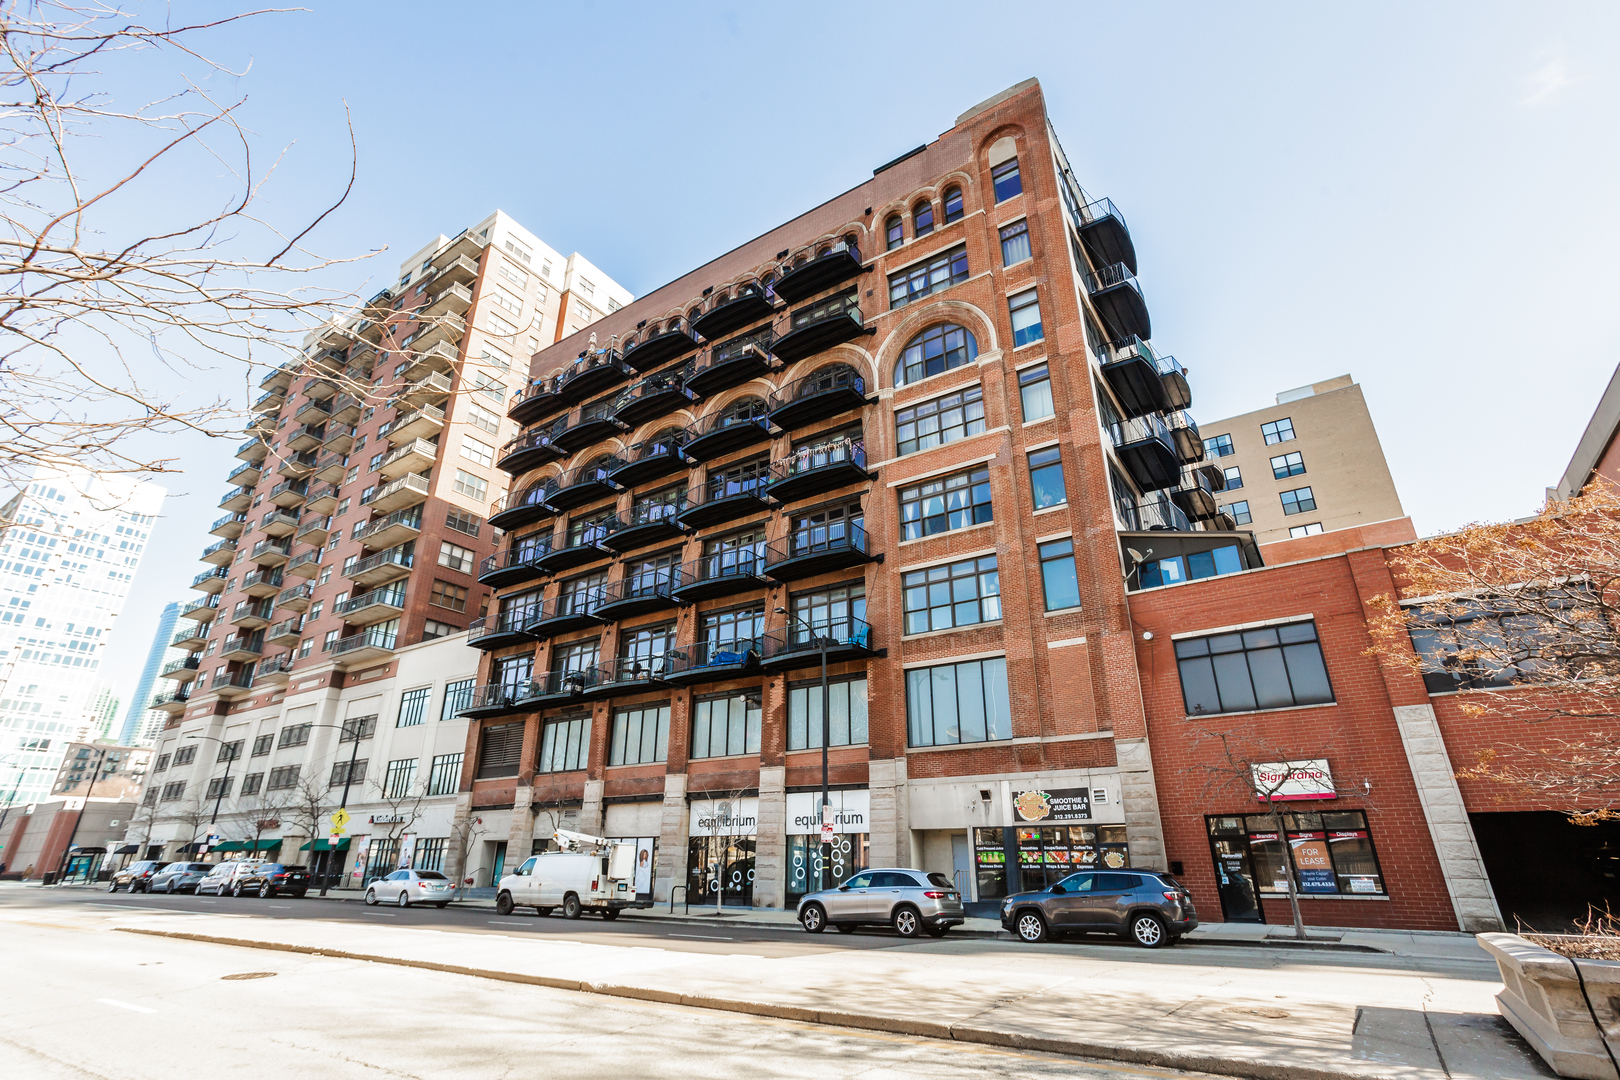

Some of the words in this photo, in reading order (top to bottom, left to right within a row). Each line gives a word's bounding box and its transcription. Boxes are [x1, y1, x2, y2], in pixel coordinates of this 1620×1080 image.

[1260, 771, 1322, 784] Signrama
[698, 814, 755, 830] equilibrium
[795, 812, 862, 829] equilrium
